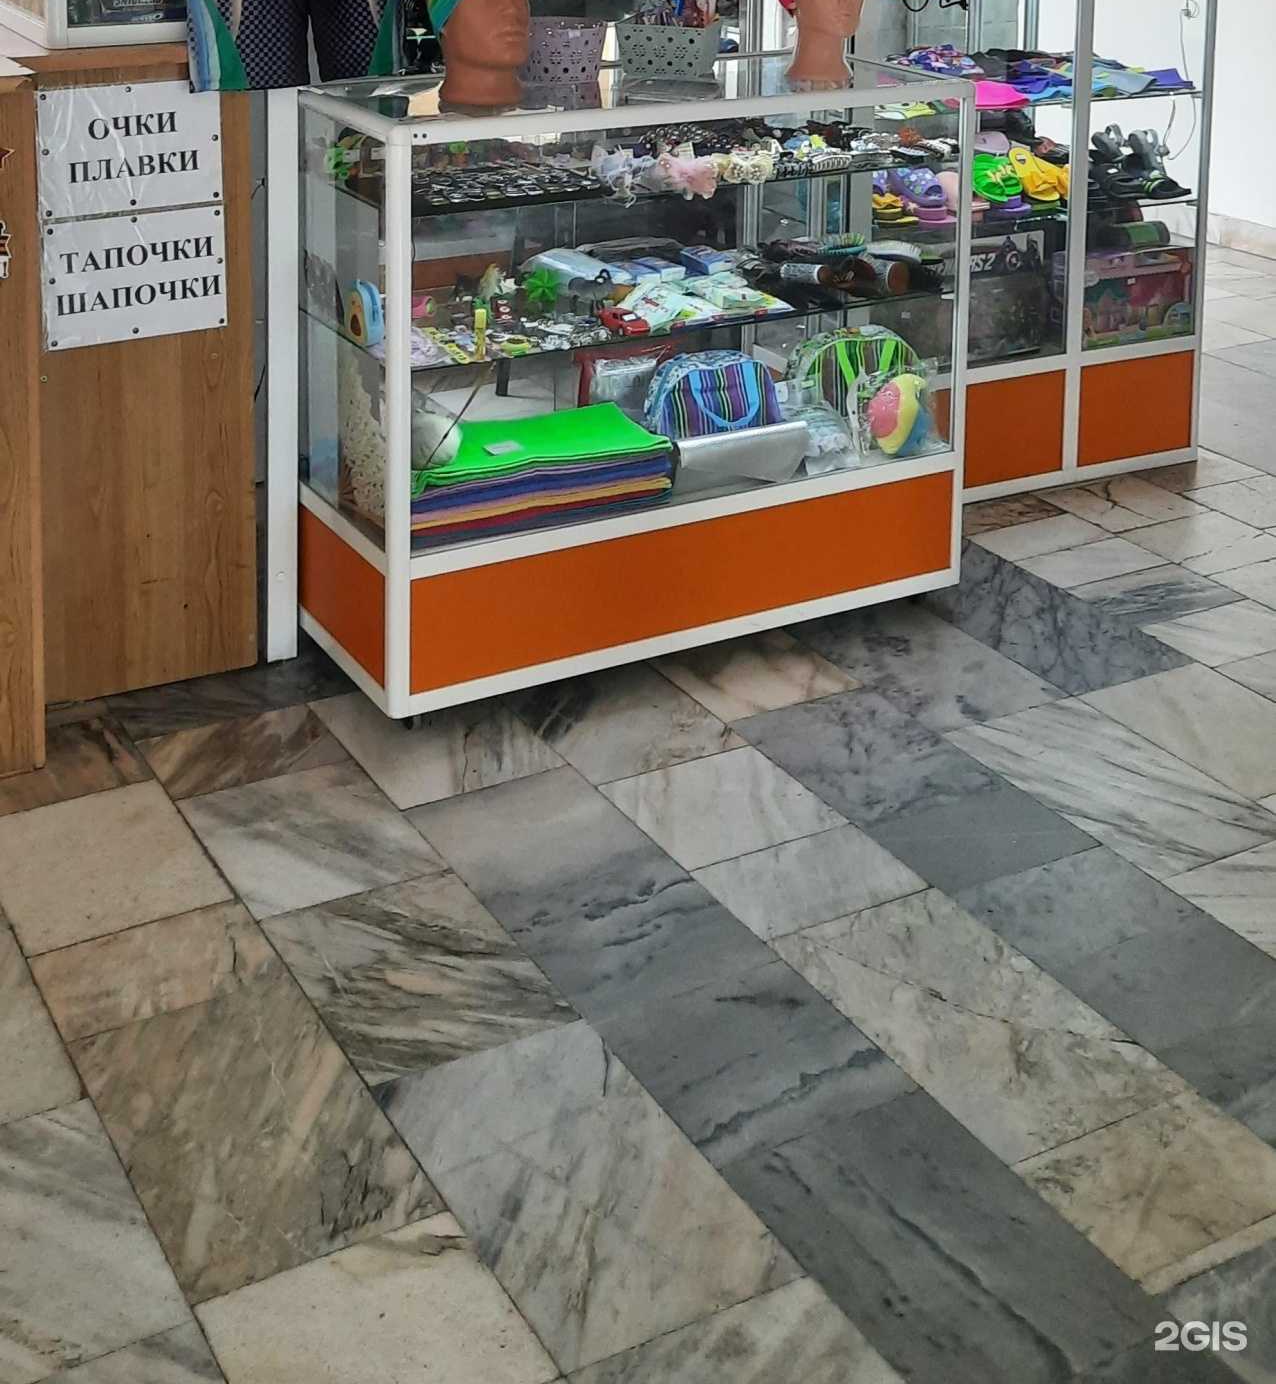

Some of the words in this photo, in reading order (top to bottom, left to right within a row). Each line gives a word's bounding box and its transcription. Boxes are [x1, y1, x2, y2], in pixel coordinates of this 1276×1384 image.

[88, 111, 178, 141] ОЧКИ
[69, 150, 200, 184] ПЛАВКИ
[60, 235, 215, 275] ТАПОЧКИ
[56, 274, 223, 317] ШАПОЧКИ
